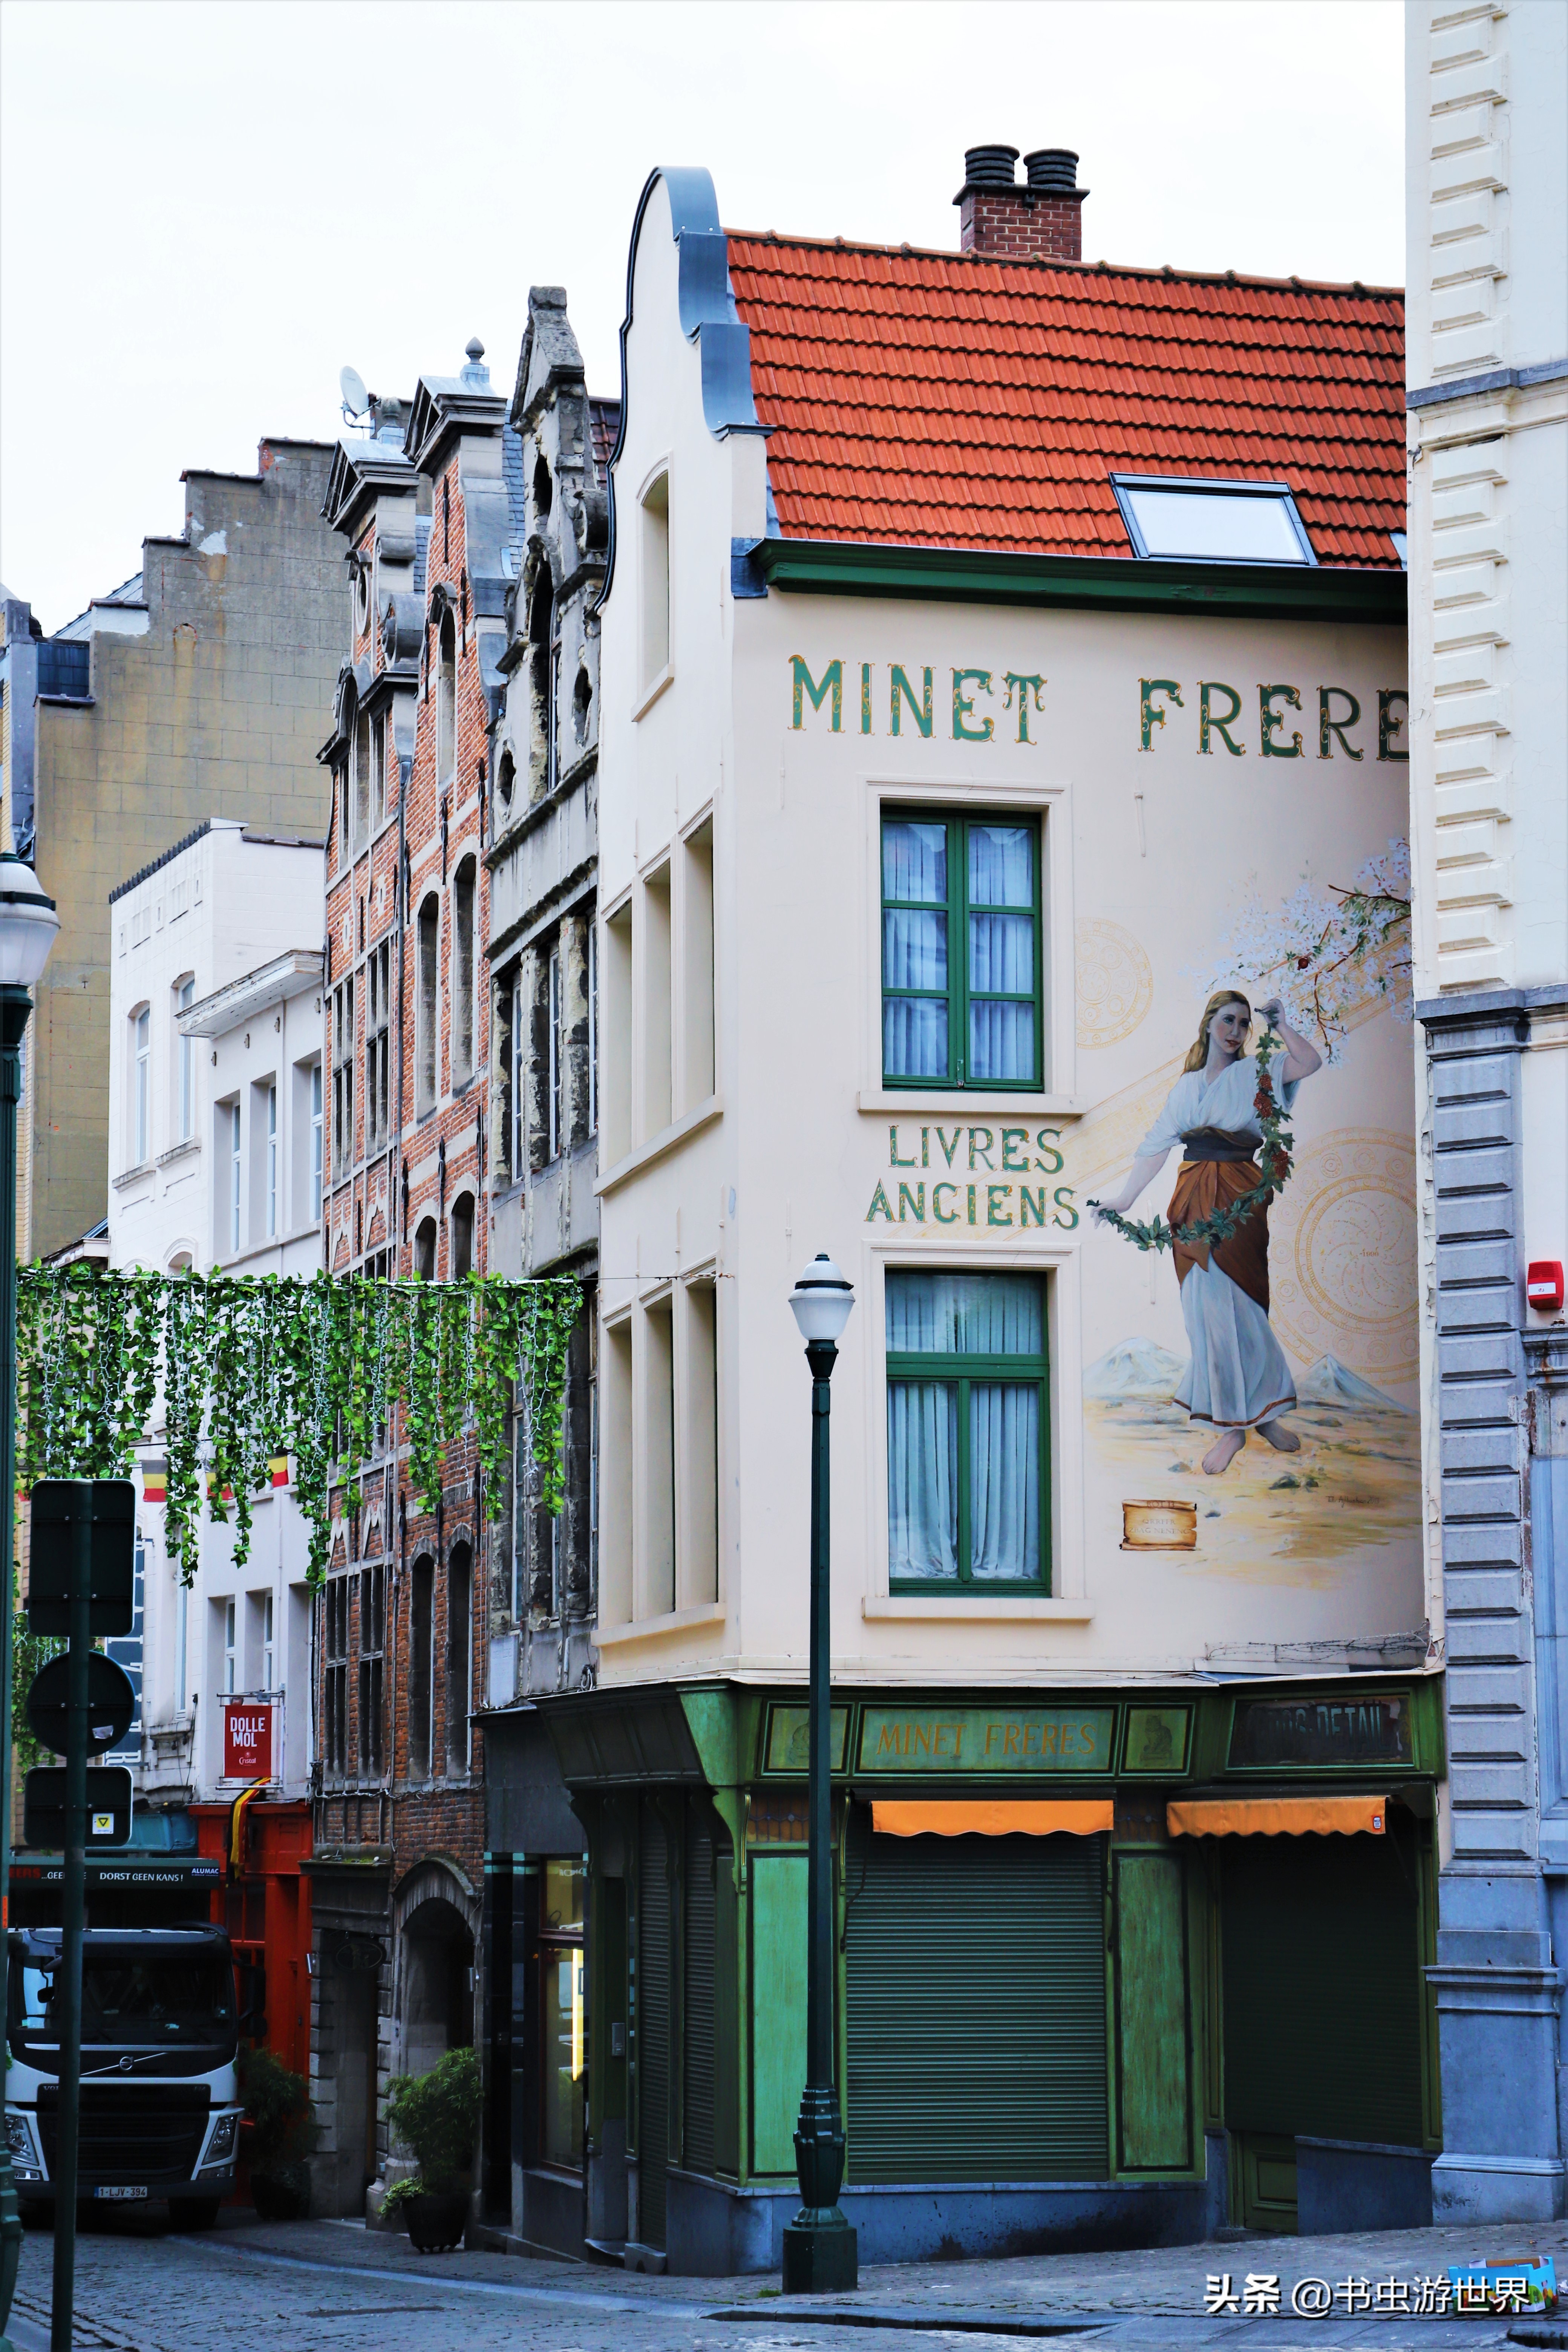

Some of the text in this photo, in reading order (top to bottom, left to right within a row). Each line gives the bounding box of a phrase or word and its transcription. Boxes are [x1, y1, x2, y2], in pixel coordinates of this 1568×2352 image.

[787, 654, 1048, 746] MINET
[888, 1125, 1064, 1174] LIVRES
[863, 1178, 1080, 1231] ANCIENS
[230, 1717, 265, 1732] DOLLE
[233, 1732, 257, 1747] MOL
[876, 1724, 1096, 1755] MINET FRERES
[239, 1756, 256, 1765] Cristal
[100, 1872, 131, 1880] DORST
[132, 1873, 155, 1881] GEEN
